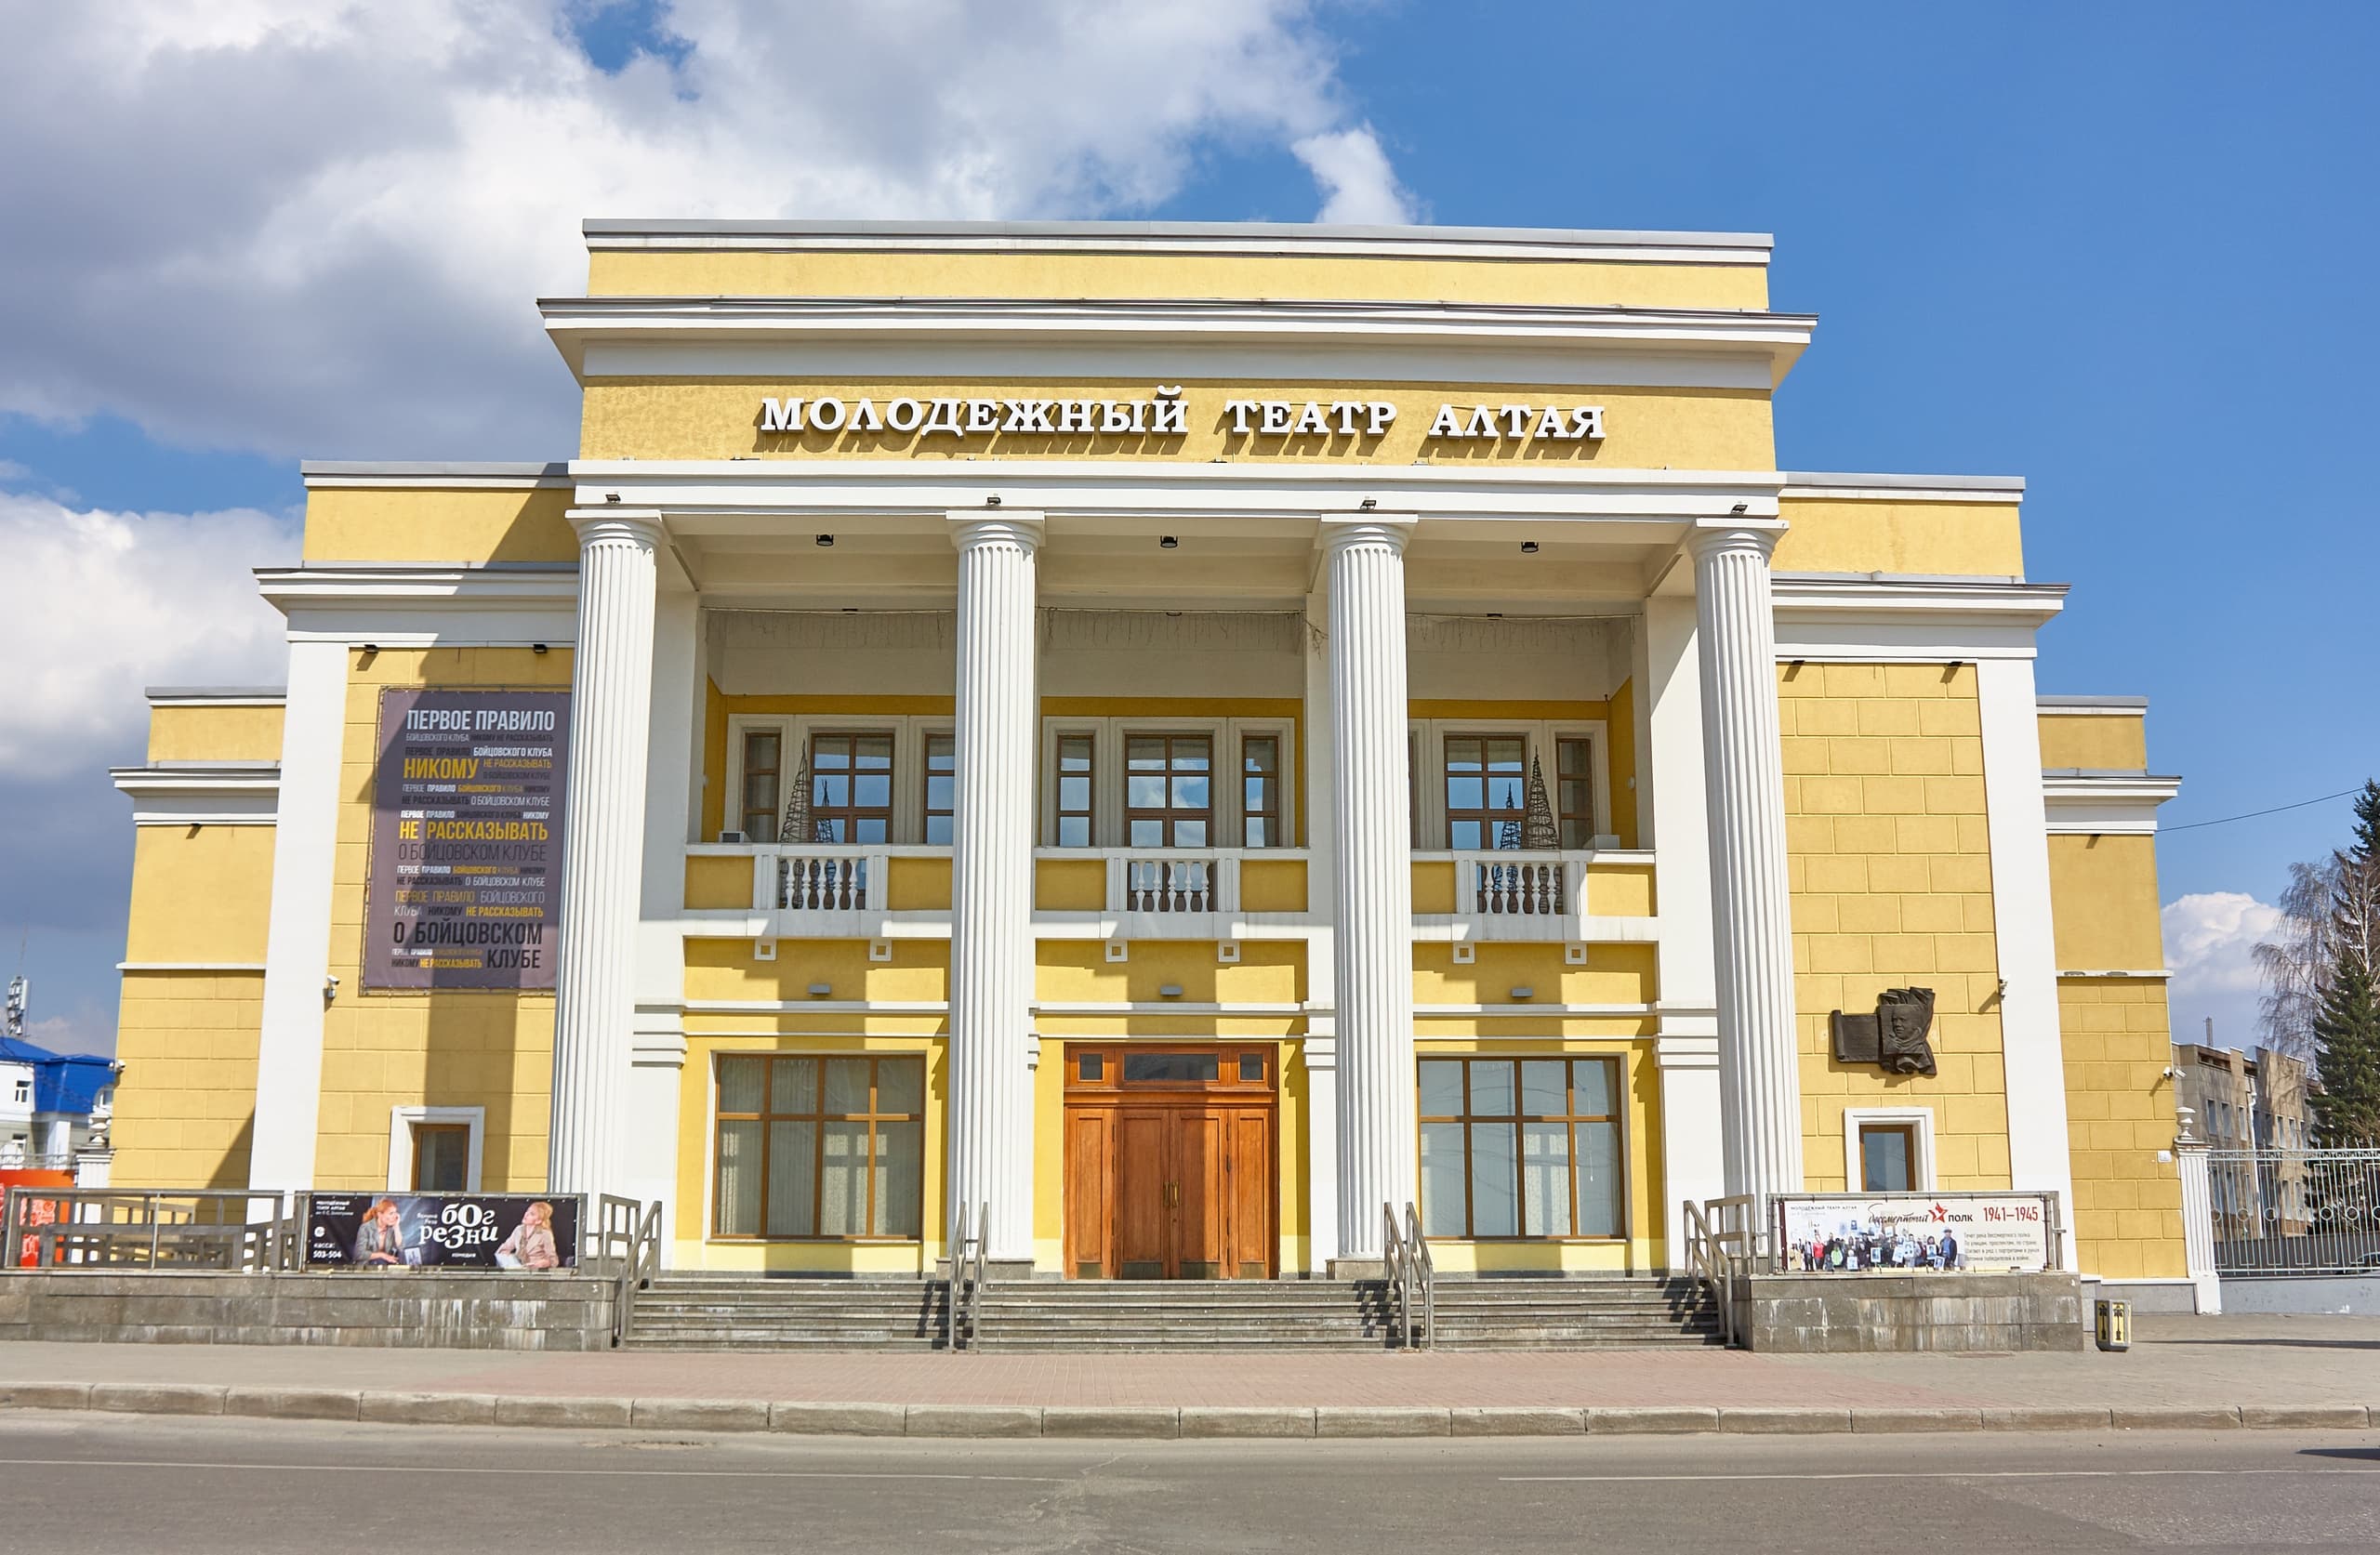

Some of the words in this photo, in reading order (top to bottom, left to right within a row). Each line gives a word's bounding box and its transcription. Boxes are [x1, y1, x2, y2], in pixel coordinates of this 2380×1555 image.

[760, 385, 1188, 439] МОЛОДЕЖНЫЙ
[1224, 400, 1397, 436] ТЕАТР
[1428, 404, 1606, 440] АЛТАЯ
[407, 710, 471, 731] ПЕРВОЕ
[476, 710, 555, 731] ПРАВИЛО
[406, 733, 447, 742] БОЙЦОВСКОГО
[449, 733, 469, 742] КЛУБА
[473, 745, 526, 758] БОЙЦОВСКОГО
[527, 748, 553, 757] КЛУБА
[403, 758, 479, 779] НИКОМУ
[483, 759, 493, 768] НЕ
[494, 759, 552, 768] РАССКАЗЫВАТЬ
[402, 784, 424, 793] ПЕРВОЕ
[427, 784, 456, 793] ПРАВИЛО
[471, 796, 476, 805] О
[477, 796, 525, 805] БОЙЦОВСКОМ
[526, 796, 550, 805] КЛУБЕ
[400, 810, 424, 819] ПЕРВОЕ
[426, 810, 455, 819] ПРАВИЛО
[523, 810, 549, 819] НИКОМУ
[400, 821, 419, 840] НЕ
[427, 821, 549, 840] РАССКАЗЫВАТЬ
[398, 843, 407, 862] О
[410, 843, 499, 862] БОЙЦОВСКОМ
[503, 843, 547, 862] КЛУБЕ
[397, 865, 420, 874] ПЕРВОЕ
[422, 865, 451, 874] ПРАВИЛО
[465, 877, 471, 886] О
[473, 877, 520, 886] БОЙЦОВСКОМ
[522, 877, 545, 886] КЛУБЕ
[395, 890, 428, 903] ПЕРВОЕ
[432, 890, 476, 903] ПРАВИЛО
[480, 890, 545, 903] БОЙЦОВСКОГО
[394, 906, 422, 917] КЛУБА
[428, 906, 462, 917] НИКОМУ
[466, 906, 476, 917] НЕ
[478, 906, 543, 917] РАССКАЗЫВАТЬ
[394, 922, 404, 943] О
[414, 918, 543, 945] БОЙЦОВСКОМ
[391, 959, 419, 968] НИКОМУ
[420, 959, 430, 968] НЕ
[431, 959, 482, 968] РАССКАЗЫВАТЬ
[487, 949, 541, 969] КЛУБЕ
